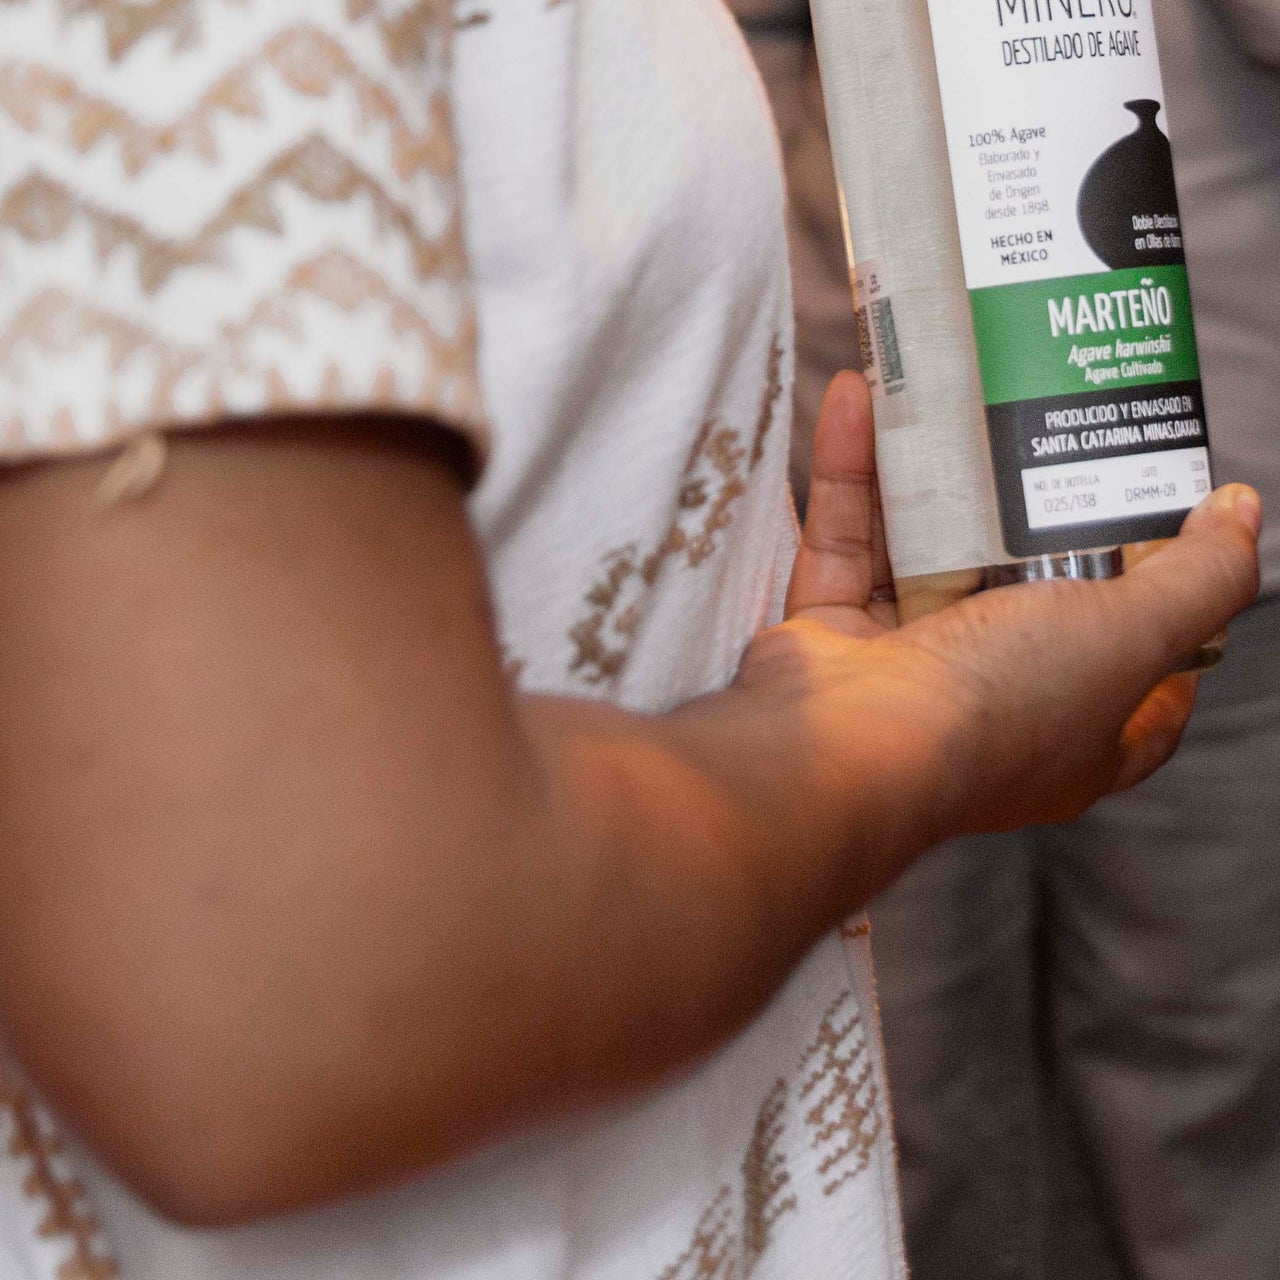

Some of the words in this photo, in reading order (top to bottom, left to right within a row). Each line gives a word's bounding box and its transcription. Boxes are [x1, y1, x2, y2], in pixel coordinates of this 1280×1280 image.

[1001, 32, 1084, 67] DESTILADO
[1087, 31, 1105, 58] DE
[1108, 30, 1142, 57] AGAVE
[969, 128, 1005, 148] 100%
[1010, 126, 1047, 144] Agave
[978, 148, 1030, 167] Elaborado
[1033, 149, 1040, 162] y
[987, 166, 1038, 183] Envasado
[989, 188, 1002, 202] de
[1005, 184, 1041, 200] Origen
[985, 205, 1017, 221] desde
[1020, 199, 1050, 217] 1898
[990, 231, 1033, 249] HECHO
[1036, 229, 1053, 243] EN
[1000, 248, 1048, 266] MÉXICO
[1047, 278, 1173, 337] MARTEÑO
[1067, 344, 1113, 368] Agave
[1084, 366, 1119, 385] Agave
[1120, 359, 1164, 379] Cultivado
[1045, 403, 1118, 430] PRODUCIDO
[1120, 402, 1131, 420] Y
[1131, 396, 1182, 419] ENVASADO
[1182, 395, 1193, 413] EN
[1031, 433, 1080, 458] SANTA
[1080, 425, 1144, 450] CATARINA
[1065, 474, 1100, 489] BOTELLA
[1043, 492, 1097, 513] 025/138
